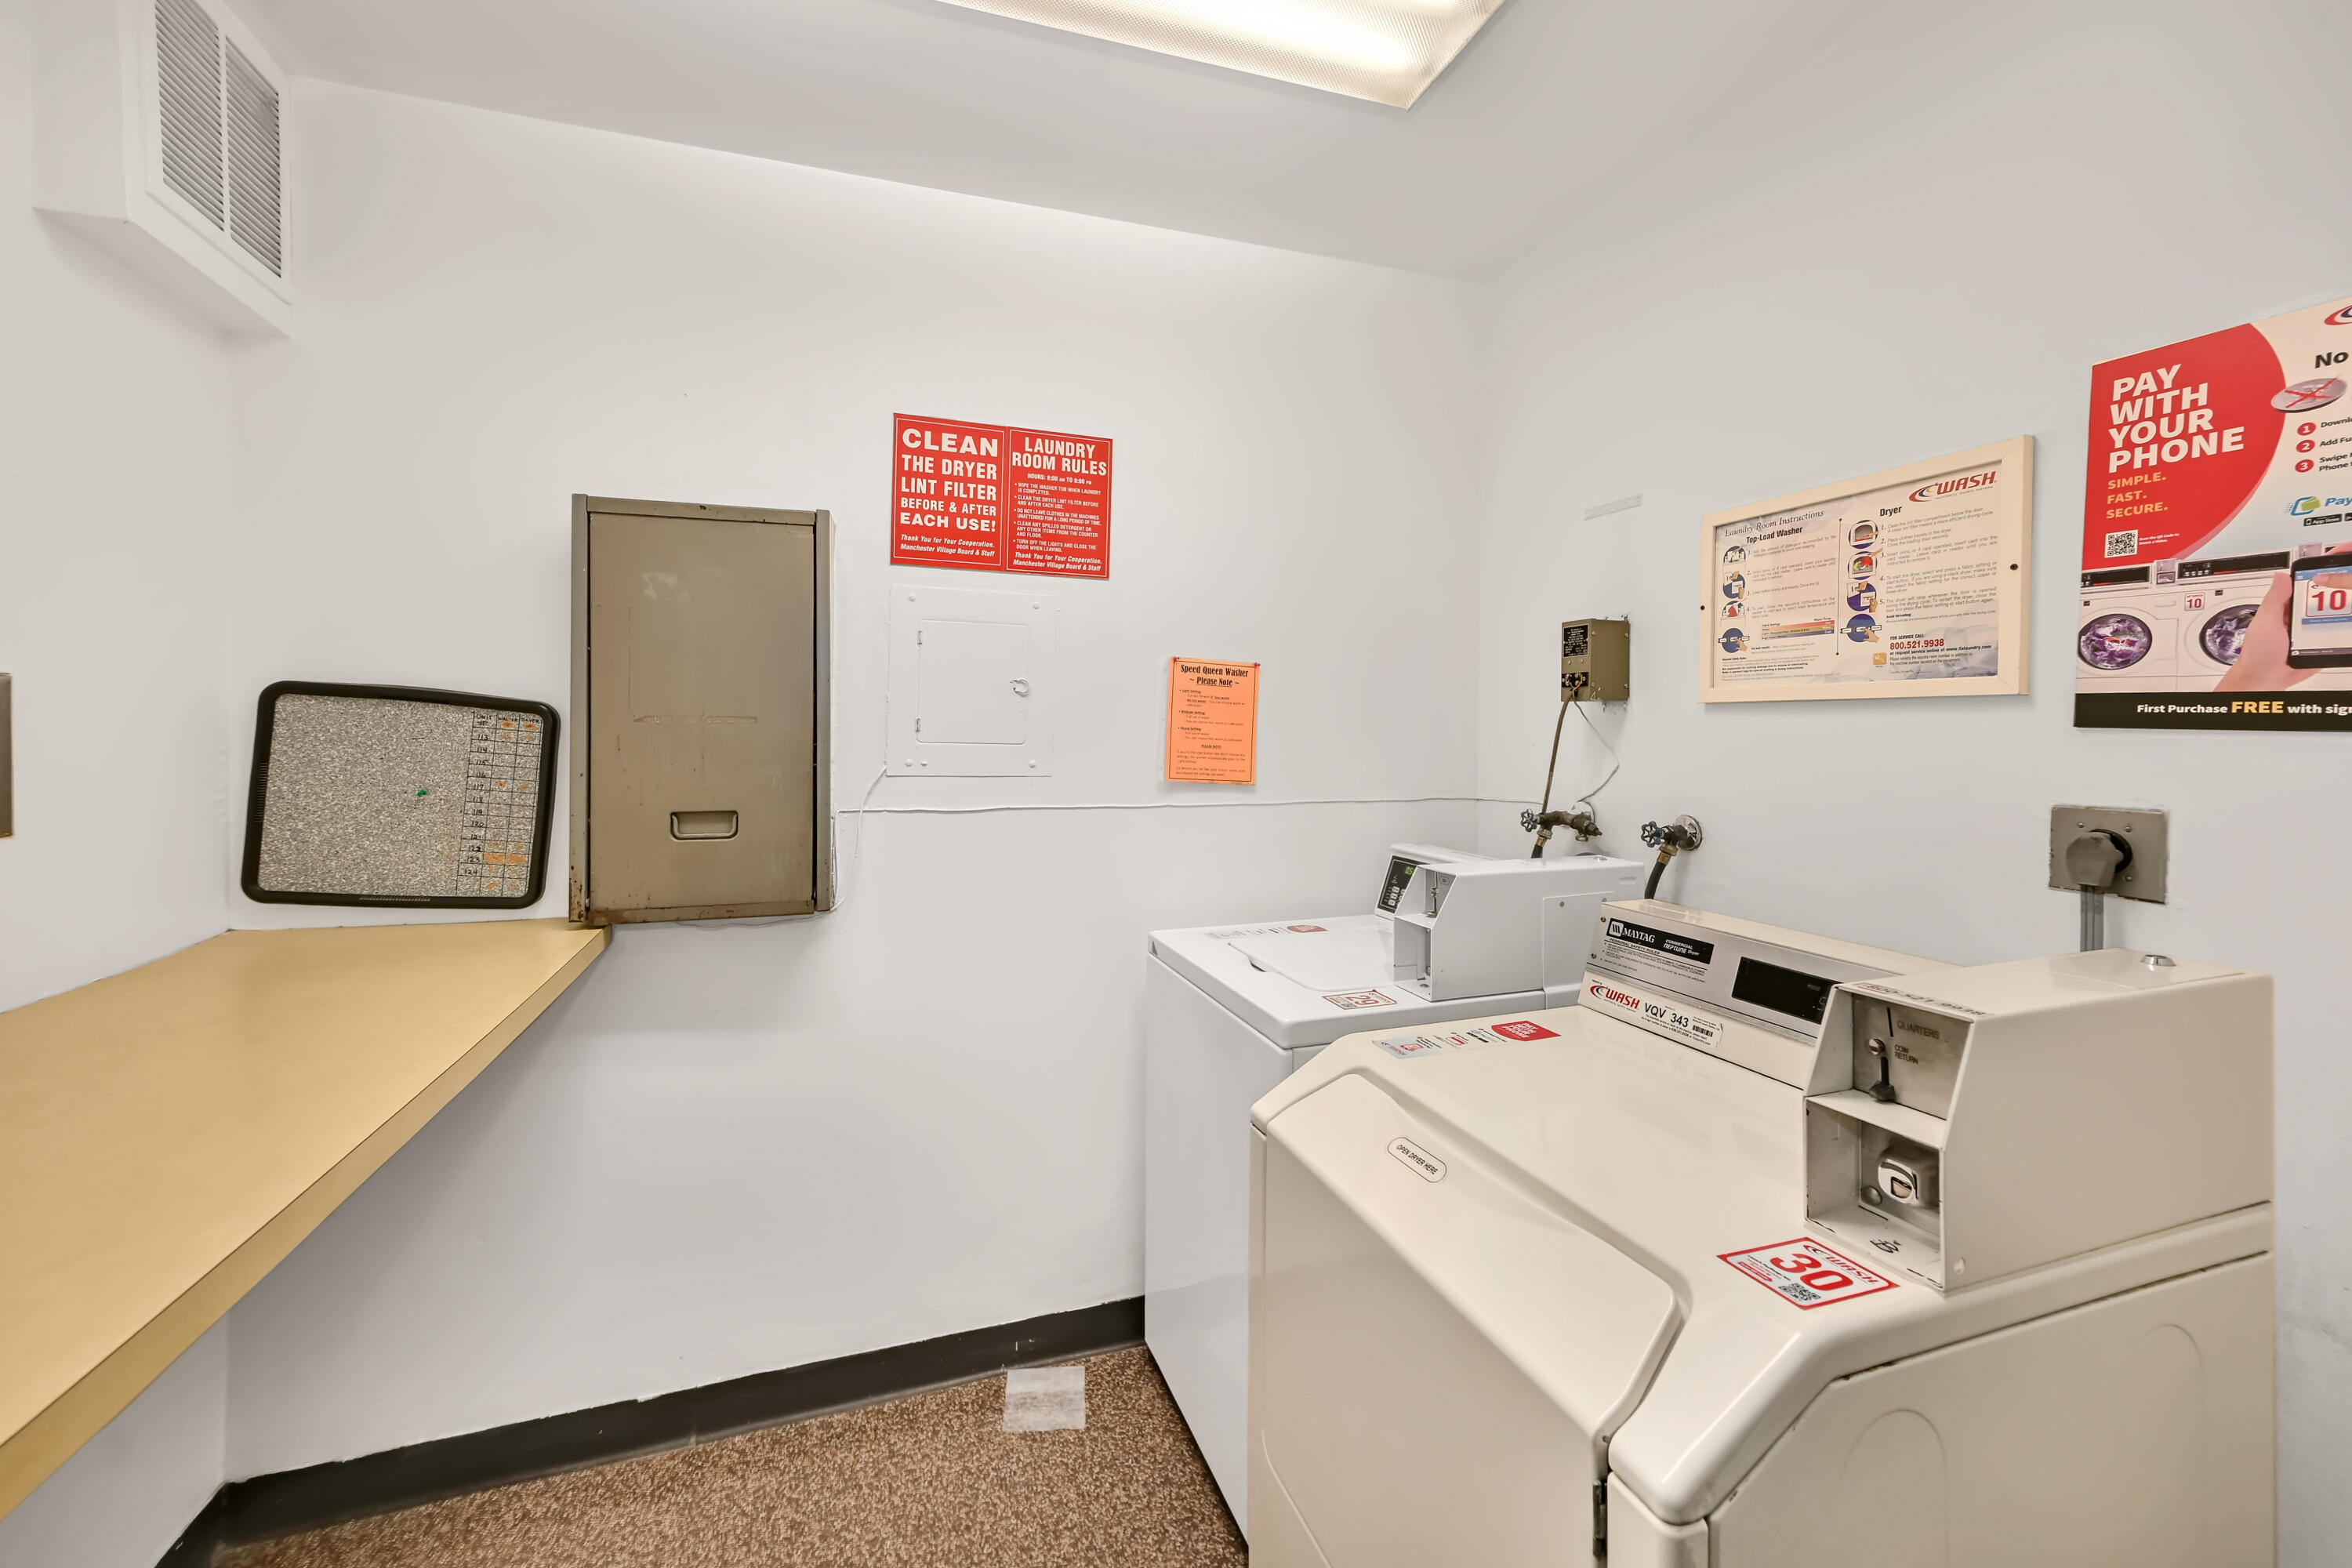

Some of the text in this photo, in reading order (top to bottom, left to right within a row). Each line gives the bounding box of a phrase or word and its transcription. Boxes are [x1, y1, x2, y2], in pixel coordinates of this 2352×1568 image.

[2315, 352, 2348, 369] No
[2112, 364, 2182, 401] PAY
[2110, 383, 2208, 425] WITH
[2108, 408, 2214, 448] YOUR
[902, 428, 998, 457] CLEAN
[1025, 437, 1095, 459] LAUNDRY
[2109, 426, 2245, 474] PHONE
[901, 454, 997, 480] THE DRYER
[1012, 452, 1107, 476] ROOM RULES
[2319, 454, 2348, 463] Swipe
[2319, 463, 2348, 471] Phone
[901, 477, 996, 501] LINT FILTER
[1936, 471, 1996, 495] WASH
[2108, 472, 2167, 490] SIMPLE.
[2107, 490, 2147, 505] FAST.
[901, 498, 996, 516] BEFORE & AFTER
[1880, 506, 1902, 517] Dryer
[2106, 502, 2168, 519] SECURE.
[900, 512, 996, 532] EACH USE!
[1725, 510, 1824, 537] Laundry Room Instructions
[958, 539, 995, 547] Cooperation.
[1746, 526, 1803, 544] Top-Load Washer
[936, 546, 956, 555] Village
[1047, 562, 1065, 570] Village
[2186, 598, 2202, 609] 10
[2311, 590, 2347, 611] 10
[1890, 639, 1944, 650] 800.521.9938
[1181, 664, 1248, 677] Speed Queen Washer
[1197, 677, 1217, 685] Please
[2137, 704, 2165, 713] First
[2168, 704, 2228, 714] Purchase
[2231, 701, 2284, 713] FREE
[2287, 704, 2322, 714] with
[1622, 928, 1693, 950] MAYTAG COMMERCIAL
[1663, 943, 1687, 954] NEPTUNE
[1606, 989, 1641, 1009] WASH
[1645, 1002, 1666, 1018] VQV
[1670, 1013, 1689, 1027] 343
[1897, 1021, 1940, 1040] QUARTERS
[1895, 1044, 1909, 1054] COIN
[1895, 1052, 1918, 1064] RETURN
[1396, 1144, 1439, 1175] OPEN DRYER HERE
[1769, 1253, 1853, 1290] 30
[1826, 1256, 1879, 1284] WASH
